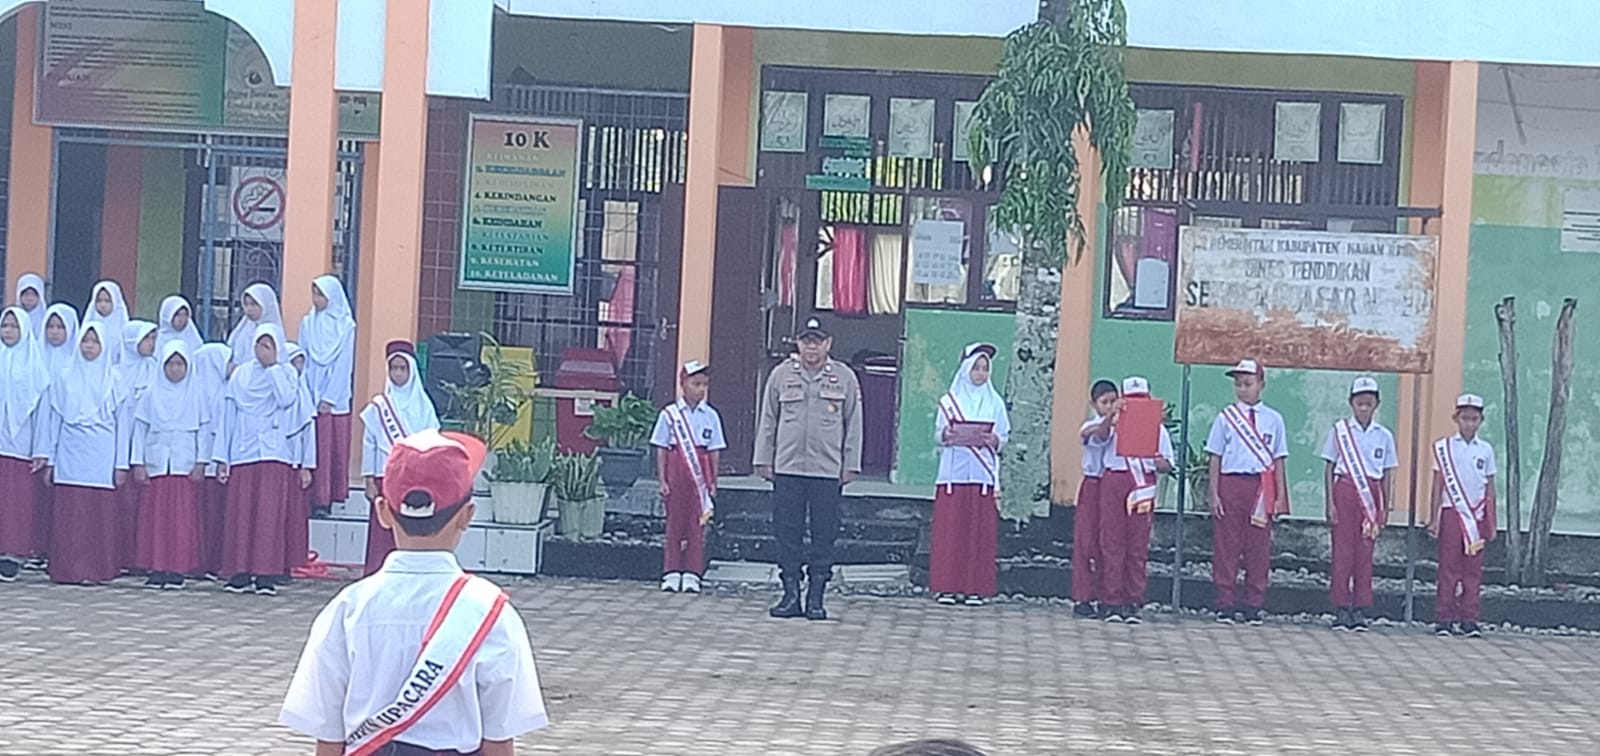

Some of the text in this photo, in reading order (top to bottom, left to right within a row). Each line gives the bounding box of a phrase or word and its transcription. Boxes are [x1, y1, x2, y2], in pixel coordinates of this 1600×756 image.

[503, 130, 550, 149] 10 K
[484, 191, 557, 202] KERINDANGAN
[480, 257, 539, 267] KESEHATAN
[484, 270, 558, 281] KETELADANAN
[1290, 260, 1371, 282] PENDIDIKAN
[376, 659, 444, 726] UPACARA
